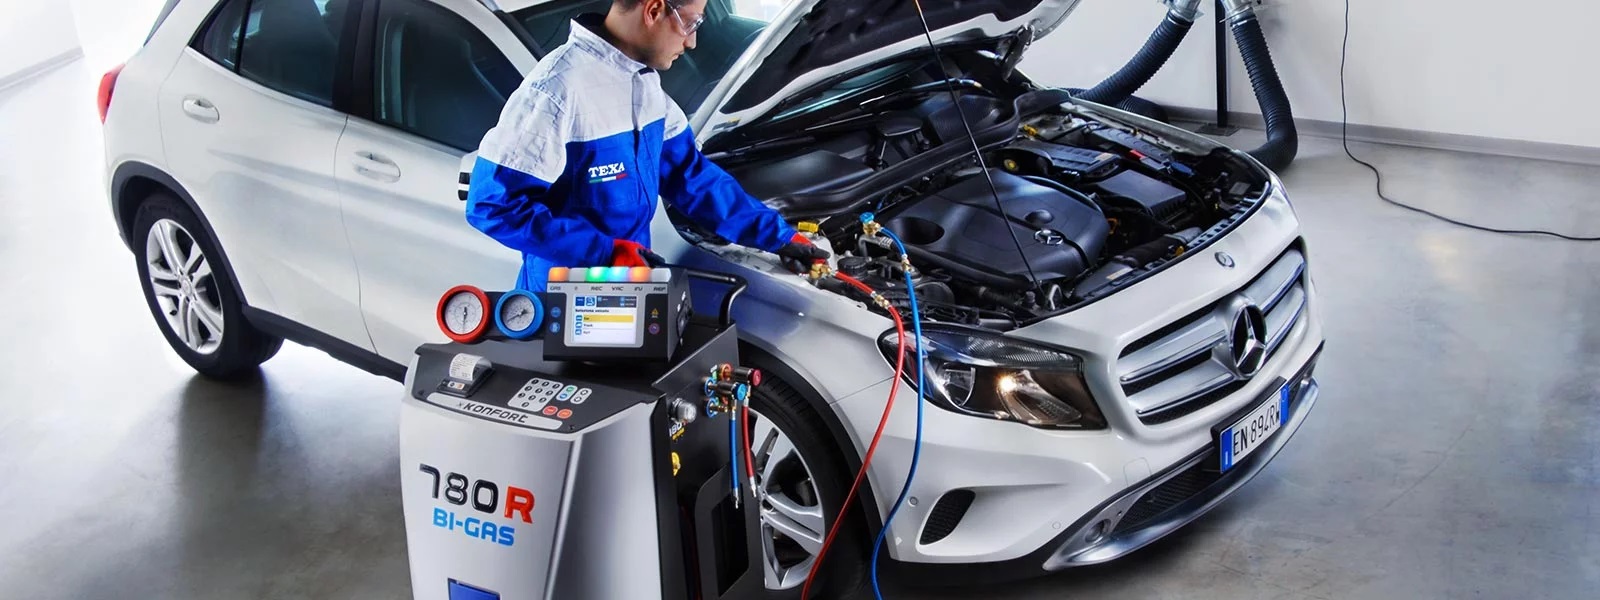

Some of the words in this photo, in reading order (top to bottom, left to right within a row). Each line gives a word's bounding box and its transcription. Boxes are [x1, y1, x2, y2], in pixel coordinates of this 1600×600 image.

[588, 162, 625, 177] TEXA
[1233, 426, 1248, 456] EN
[433, 507, 516, 547] BI-GAS
